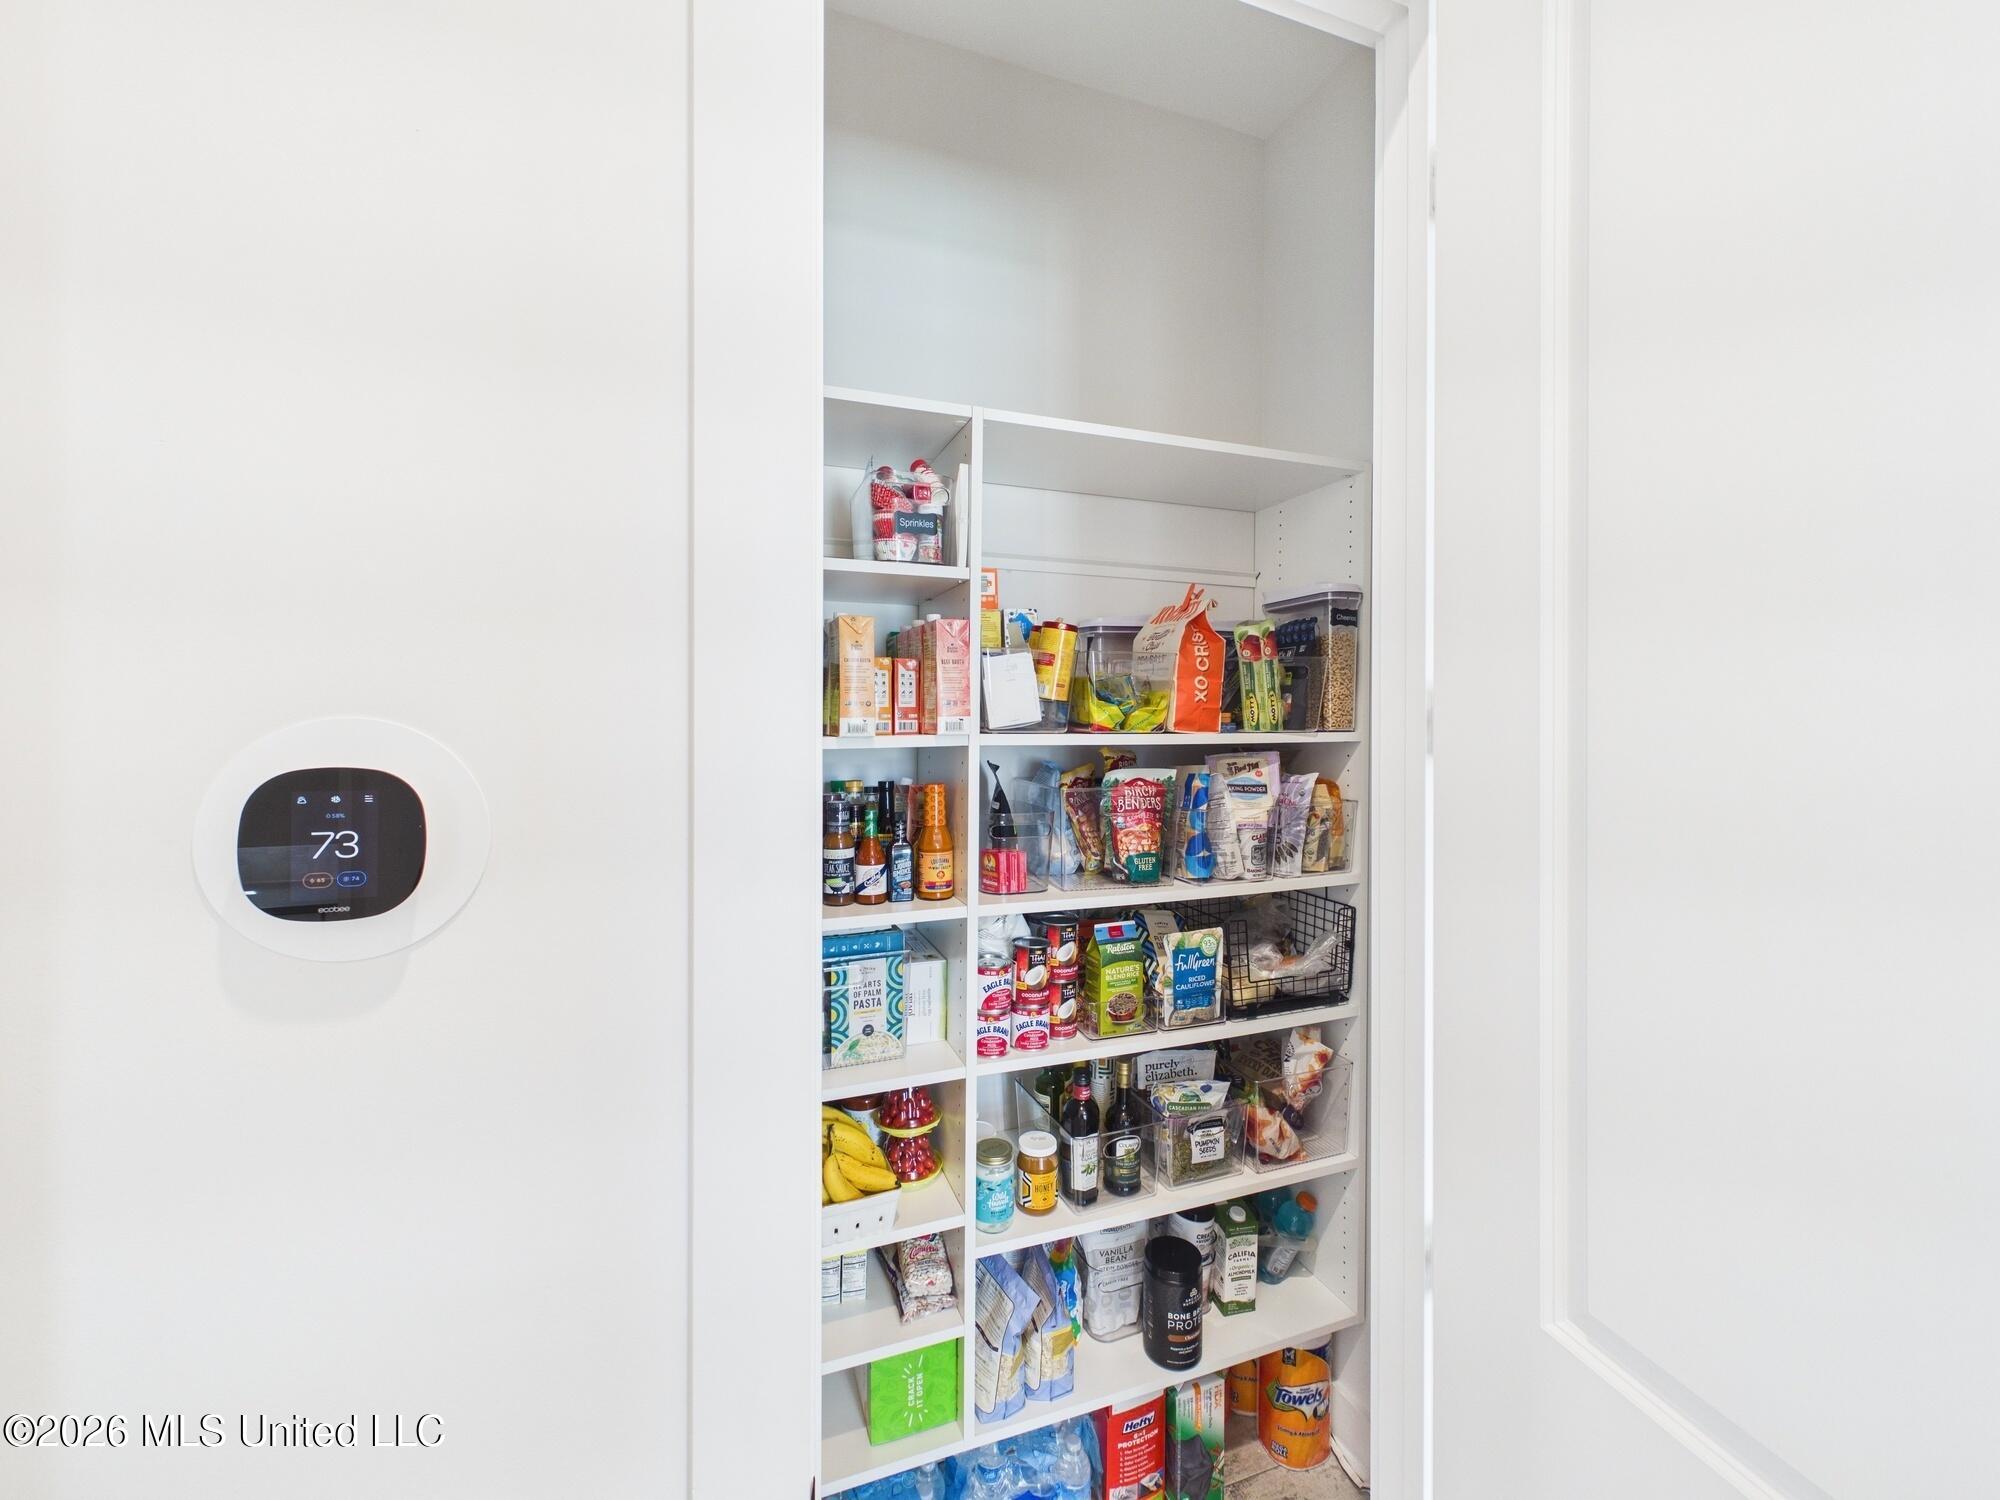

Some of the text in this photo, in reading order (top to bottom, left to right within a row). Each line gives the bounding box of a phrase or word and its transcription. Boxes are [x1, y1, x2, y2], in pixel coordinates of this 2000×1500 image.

[900, 518, 934, 528] Sprinkles
[1124, 785, 1156, 797] BIRCH
[1117, 797, 1161, 812] BENDERS
[310, 830, 359, 860] 73
[1062, 932, 1076, 940] THAI
[1106, 942, 1135, 954] Ralston
[1105, 964, 1139, 975] NATURE'S
[1188, 974, 1206, 982] RICED
[983, 979, 1002, 993] EAGLE
[1175, 980, 1215, 990] CAULIFLOWER
[864, 989, 881, 997] PALM
[854, 998, 882, 1009] PASTA
[977, 1026, 991, 1036] AGLE
[1016, 1020, 1034, 1031] EAGLE
[1145, 1059, 1179, 1073] purely
[1145, 1067, 1198, 1082] elizabeth.
[1195, 1138, 1220, 1148] PUMPKIN
[1199, 1146, 1217, 1155] SEEDS
[1034, 1183, 1053, 1193] HONEY
[1100, 1244, 1134, 1257] VANILLA
[1228, 1250, 1256, 1260] CALIFIA
[1105, 1254, 1128, 1264] BEAN
[1168, 1312, 1191, 1320] BONE
[1274, 1386, 1323, 1405] Towels
[916, 1400, 923, 1408] IT
[1125, 1415, 1154, 1432] Hefty
[1118, 1427, 1159, 1449] PROTECTION
